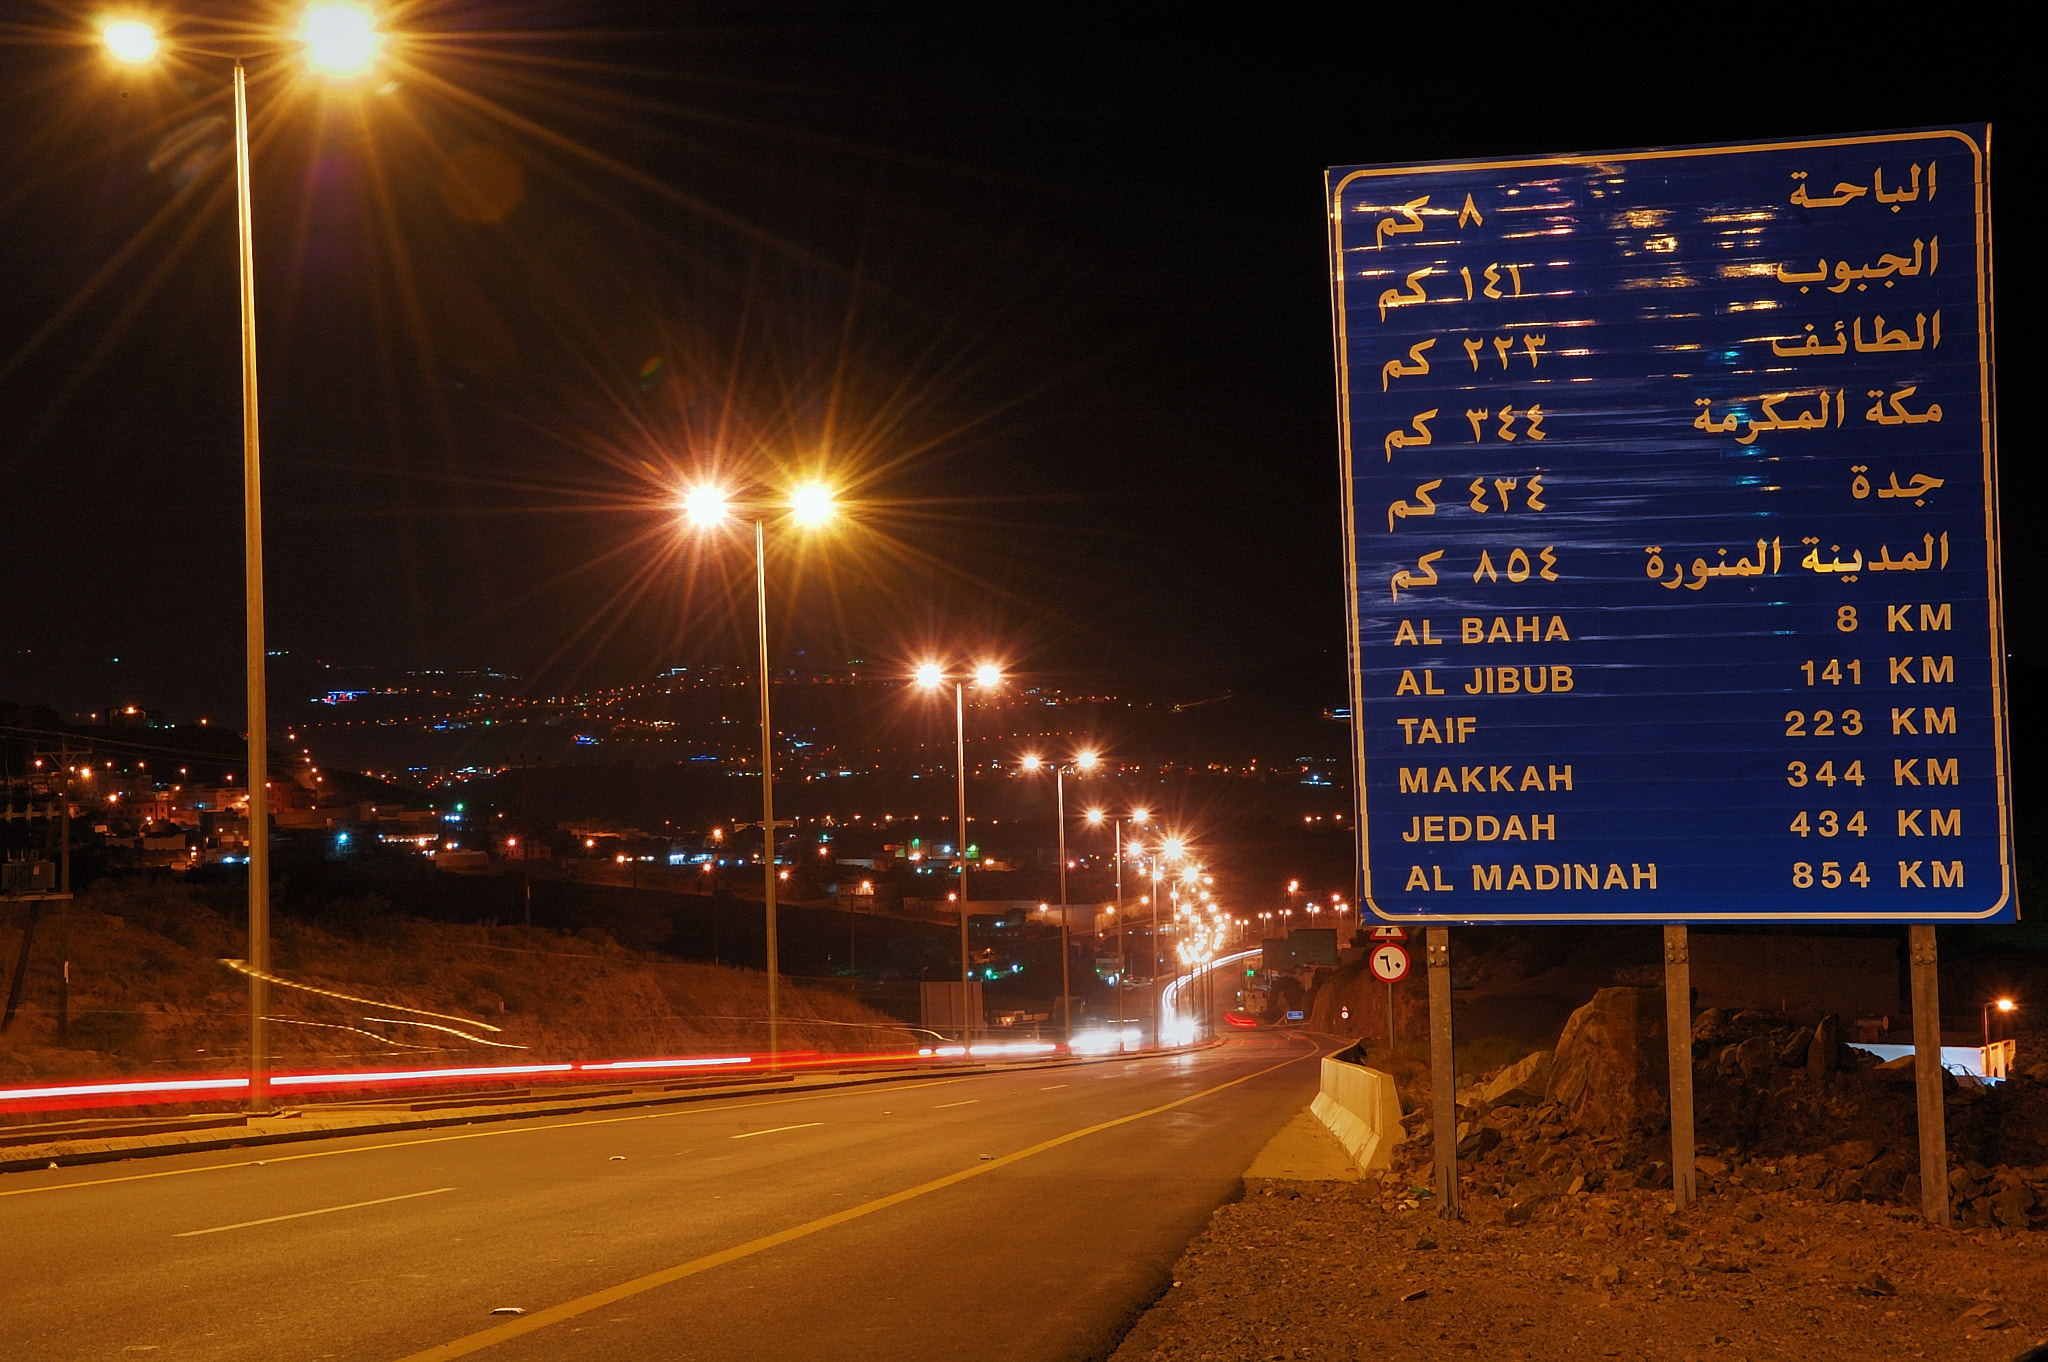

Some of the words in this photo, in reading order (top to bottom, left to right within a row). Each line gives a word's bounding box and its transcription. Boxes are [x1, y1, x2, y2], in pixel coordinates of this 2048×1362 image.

[1790, 161, 1938, 213] الباحة
[1376, 195, 1431, 251] كم
[1458, 193, 1484, 229] ٨
[1460, 262, 1521, 301] ١٤١
[1776, 235, 1939, 294] الجبوب
[1378, 266, 1434, 323] كم
[1463, 333, 1546, 372] ٢٢٣
[1772, 309, 1942, 357] الطائف
[1382, 337, 1437, 393] كم
[1465, 403, 1547, 443] ٣٤٤
[1693, 388, 1845, 445] المكرمة
[1865, 386, 1943, 425] مكة
[1384, 408, 1439, 463] كم
[1387, 478, 1443, 533] كم
[1469, 474, 1546, 514] ٤٣٤
[1850, 465, 1945, 507] جدة
[1390, 549, 1445, 603] كم
[1472, 544, 1559, 584] ٨٥٤
[1644, 536, 1782, 591] المنورة
[1801, 531, 1949, 583] المدينة
[1393, 619, 1443, 646] AL
[1461, 615, 1570, 644] BAHA
[1836, 605, 1858, 632] 8
[1887, 603, 1952, 632] KM
[1395, 669, 1445, 696] AL
[1464, 665, 1574, 695] JIBUB
[1800, 658, 1862, 686] 141
[1888, 655, 1954, 684] KM
[1396, 716, 1477, 745] TAIF
[1784, 709, 1863, 737] 223
[1891, 706, 1957, 735] KM
[1399, 764, 1573, 794] MAKKAH
[1787, 760, 1866, 788] 344
[1894, 758, 1959, 786] KM
[1402, 814, 1556, 843] JEDDAH
[1789, 810, 1868, 838] 434
[1897, 809, 1961, 837] KM
[1405, 865, 1454, 892] AL
[1471, 863, 1657, 891] MADINAH
[1792, 860, 1871, 889] 854
[1898, 860, 1964, 888] KM
[1379, 955, 1401, 973] ٦٠
